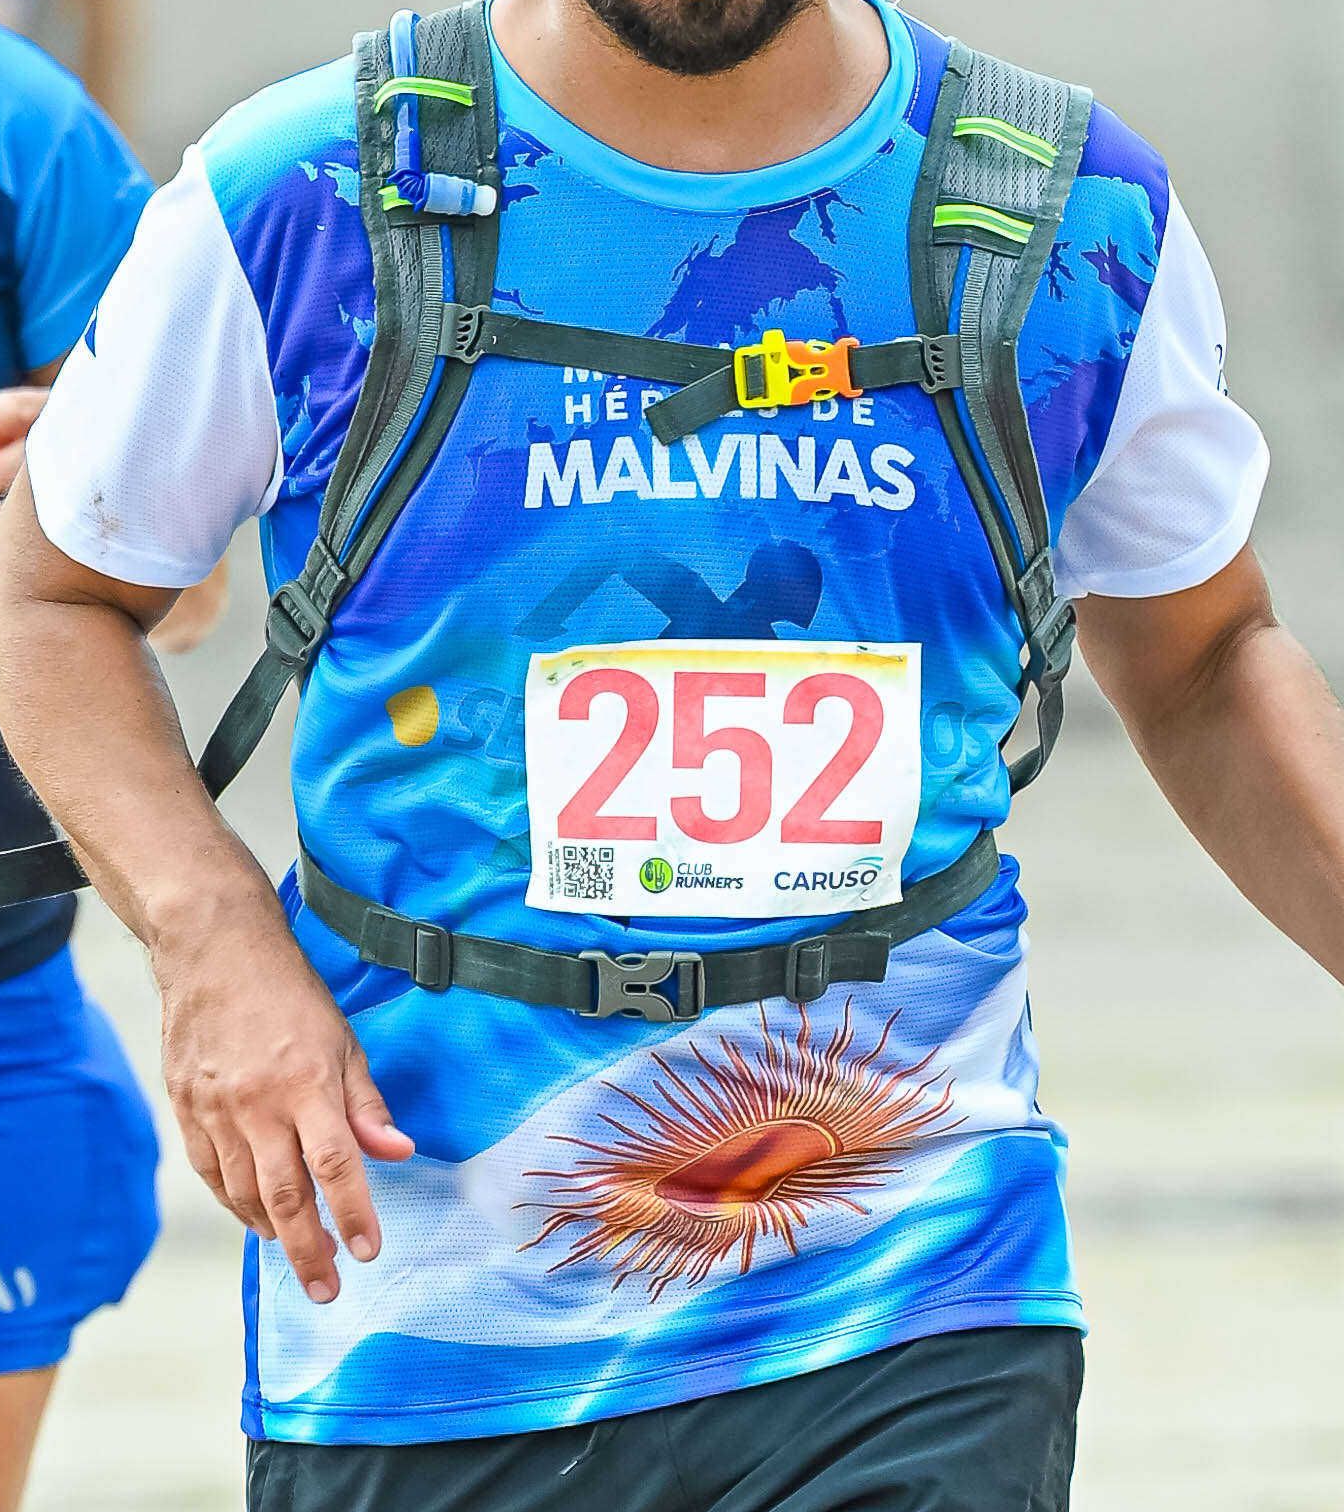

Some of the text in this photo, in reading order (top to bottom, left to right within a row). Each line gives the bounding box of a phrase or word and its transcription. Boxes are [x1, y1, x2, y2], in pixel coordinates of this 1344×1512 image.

[524, 433, 916, 511] MALVINAS
[557, 668, 884, 845] 252
[677, 862, 713, 875] CLUB
[774, 869, 878, 892] CARUSO
